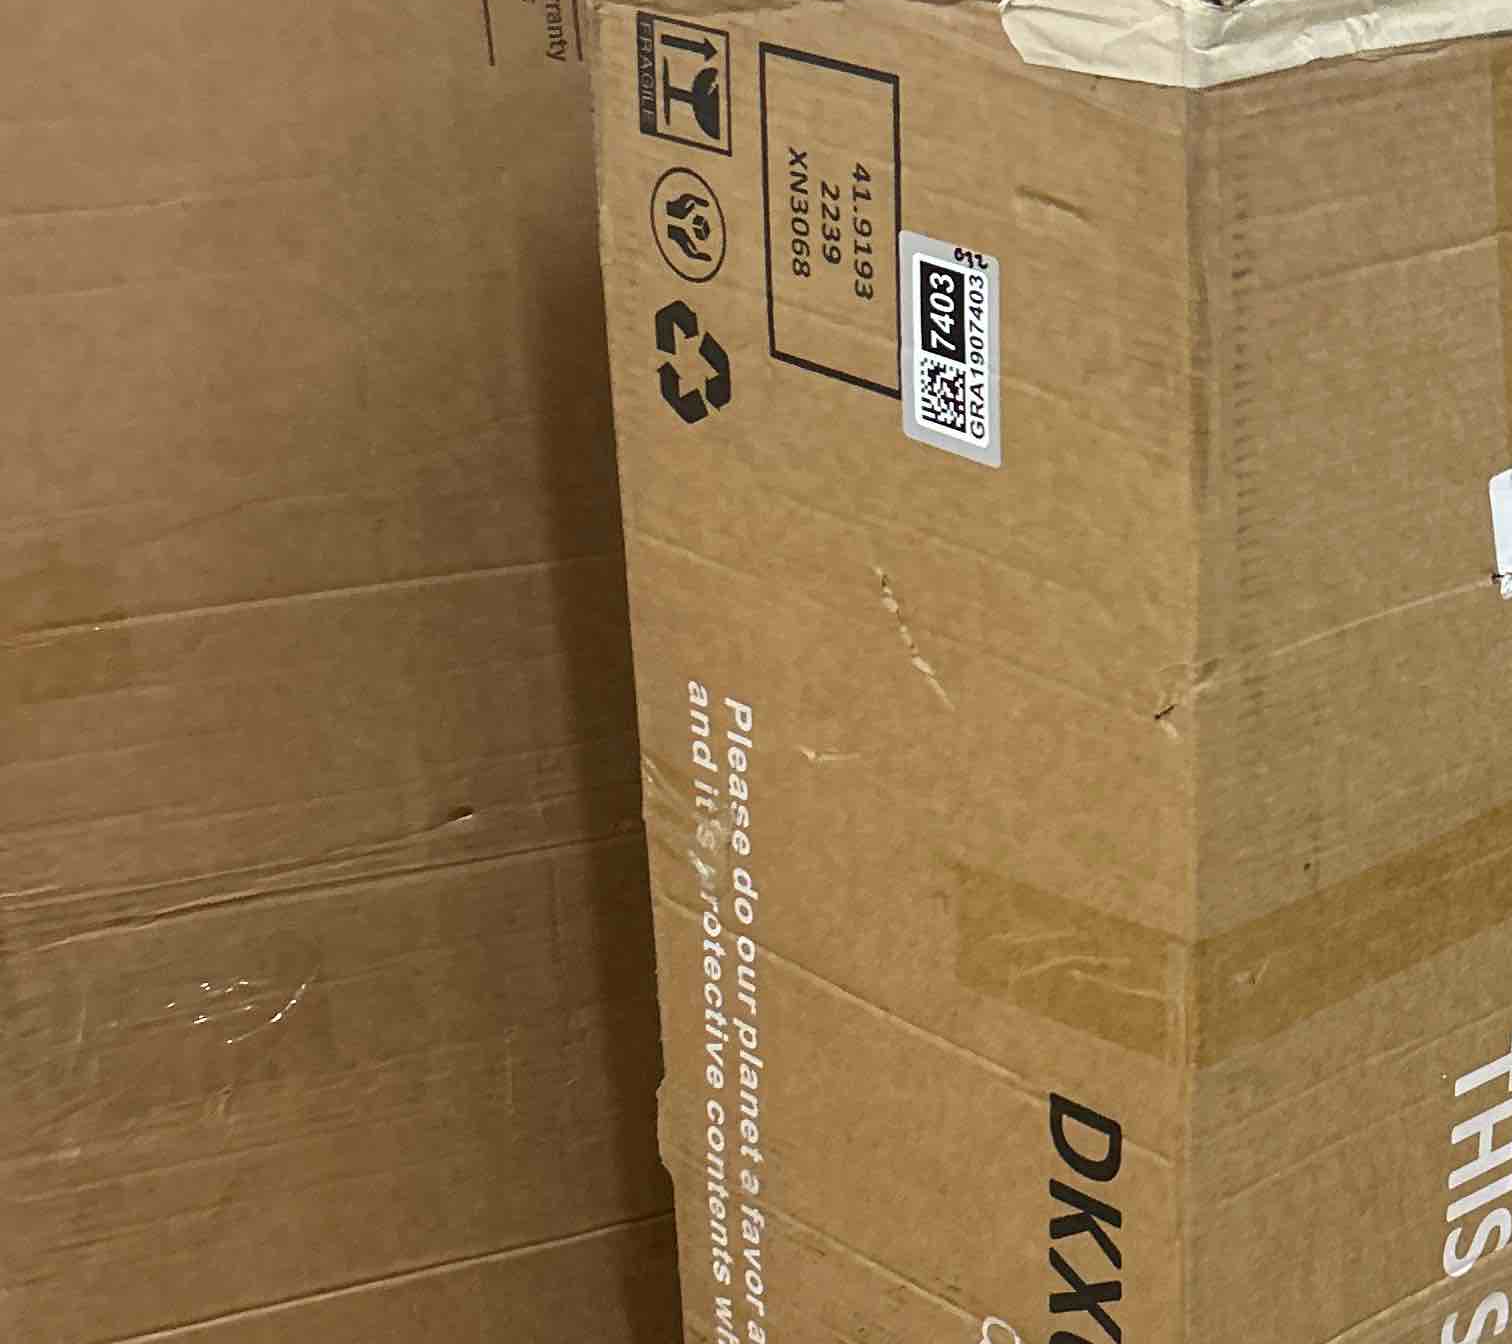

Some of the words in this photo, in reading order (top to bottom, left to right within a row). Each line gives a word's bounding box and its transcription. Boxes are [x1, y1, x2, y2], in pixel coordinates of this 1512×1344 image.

[789, 146, 811, 280] XN3068
[820, 181, 842, 265] 2239
[851, 162, 874, 301] 41.9193
[927, 272, 957, 353] 7403
[968, 274, 986, 440] GRA1907403
[724, 696, 754, 857] Please
[732, 866, 760, 926] do
[688, 679, 719, 774] and
[704, 1099, 734, 1286] contents
[735, 935, 759, 1017] our
[732, 1016, 765, 1165] planet
[739, 1166, 760, 1195] a
[739, 1202, 766, 1317] favor
